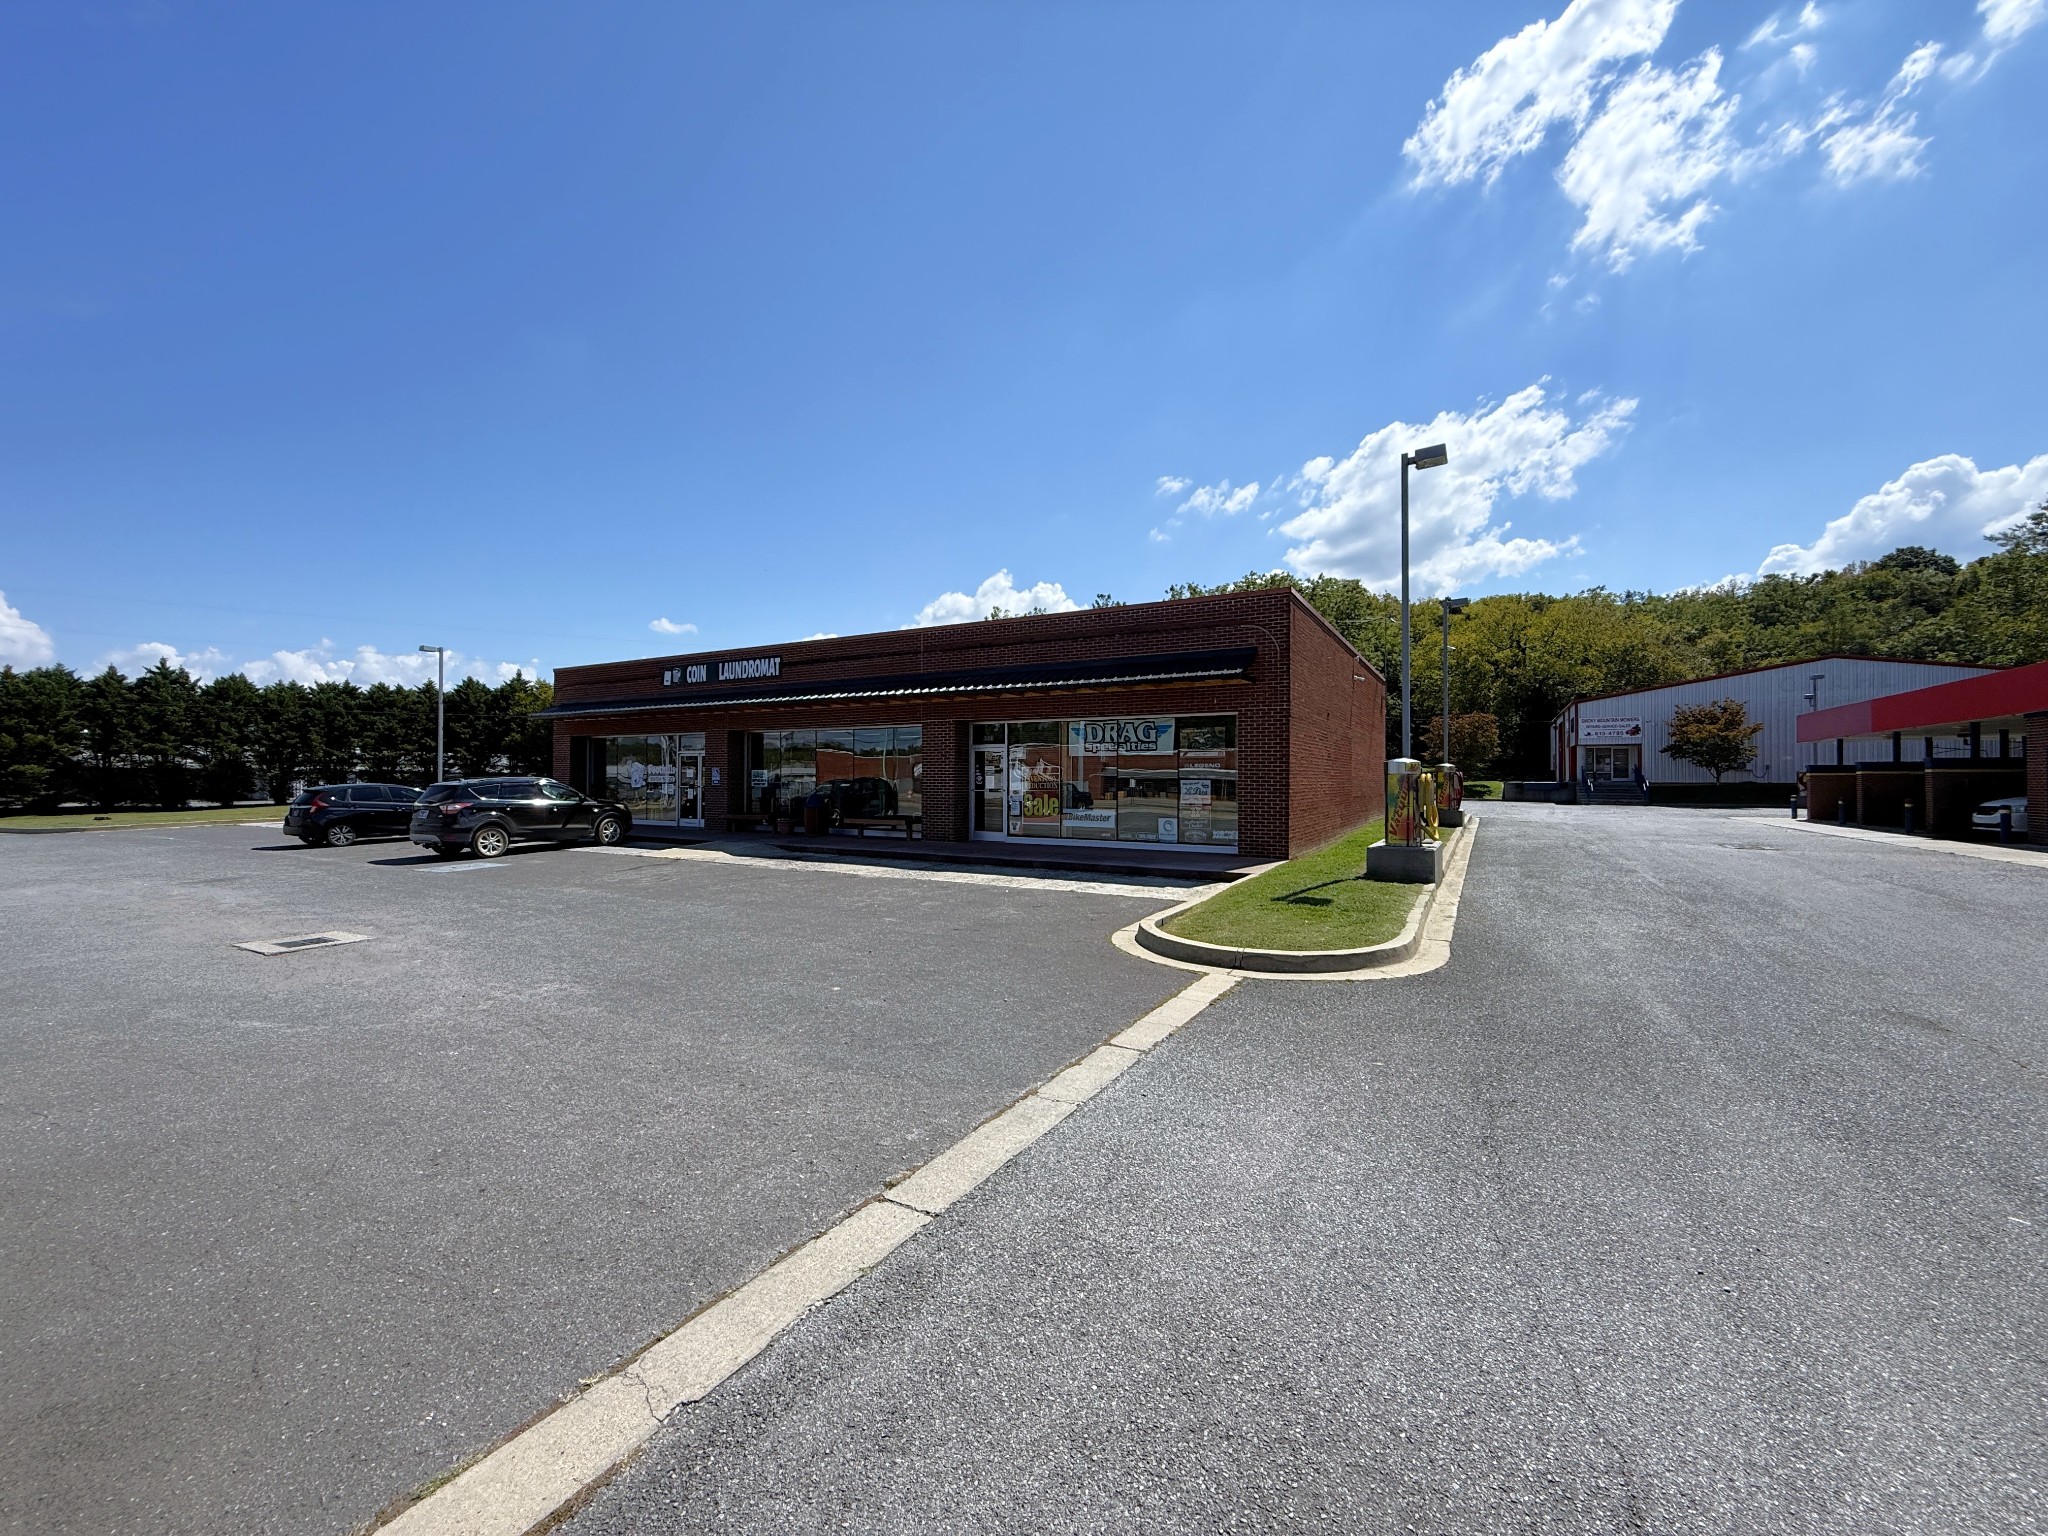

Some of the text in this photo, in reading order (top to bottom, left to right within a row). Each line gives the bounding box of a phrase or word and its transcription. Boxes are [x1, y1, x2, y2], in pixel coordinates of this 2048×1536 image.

[687, 657, 780, 683] COIN LAUNDROMAT
[1084, 721, 1158, 743] DRAG
[1023, 793, 1059, 817] Sale
[1068, 812, 1111, 822] BikeMaster
